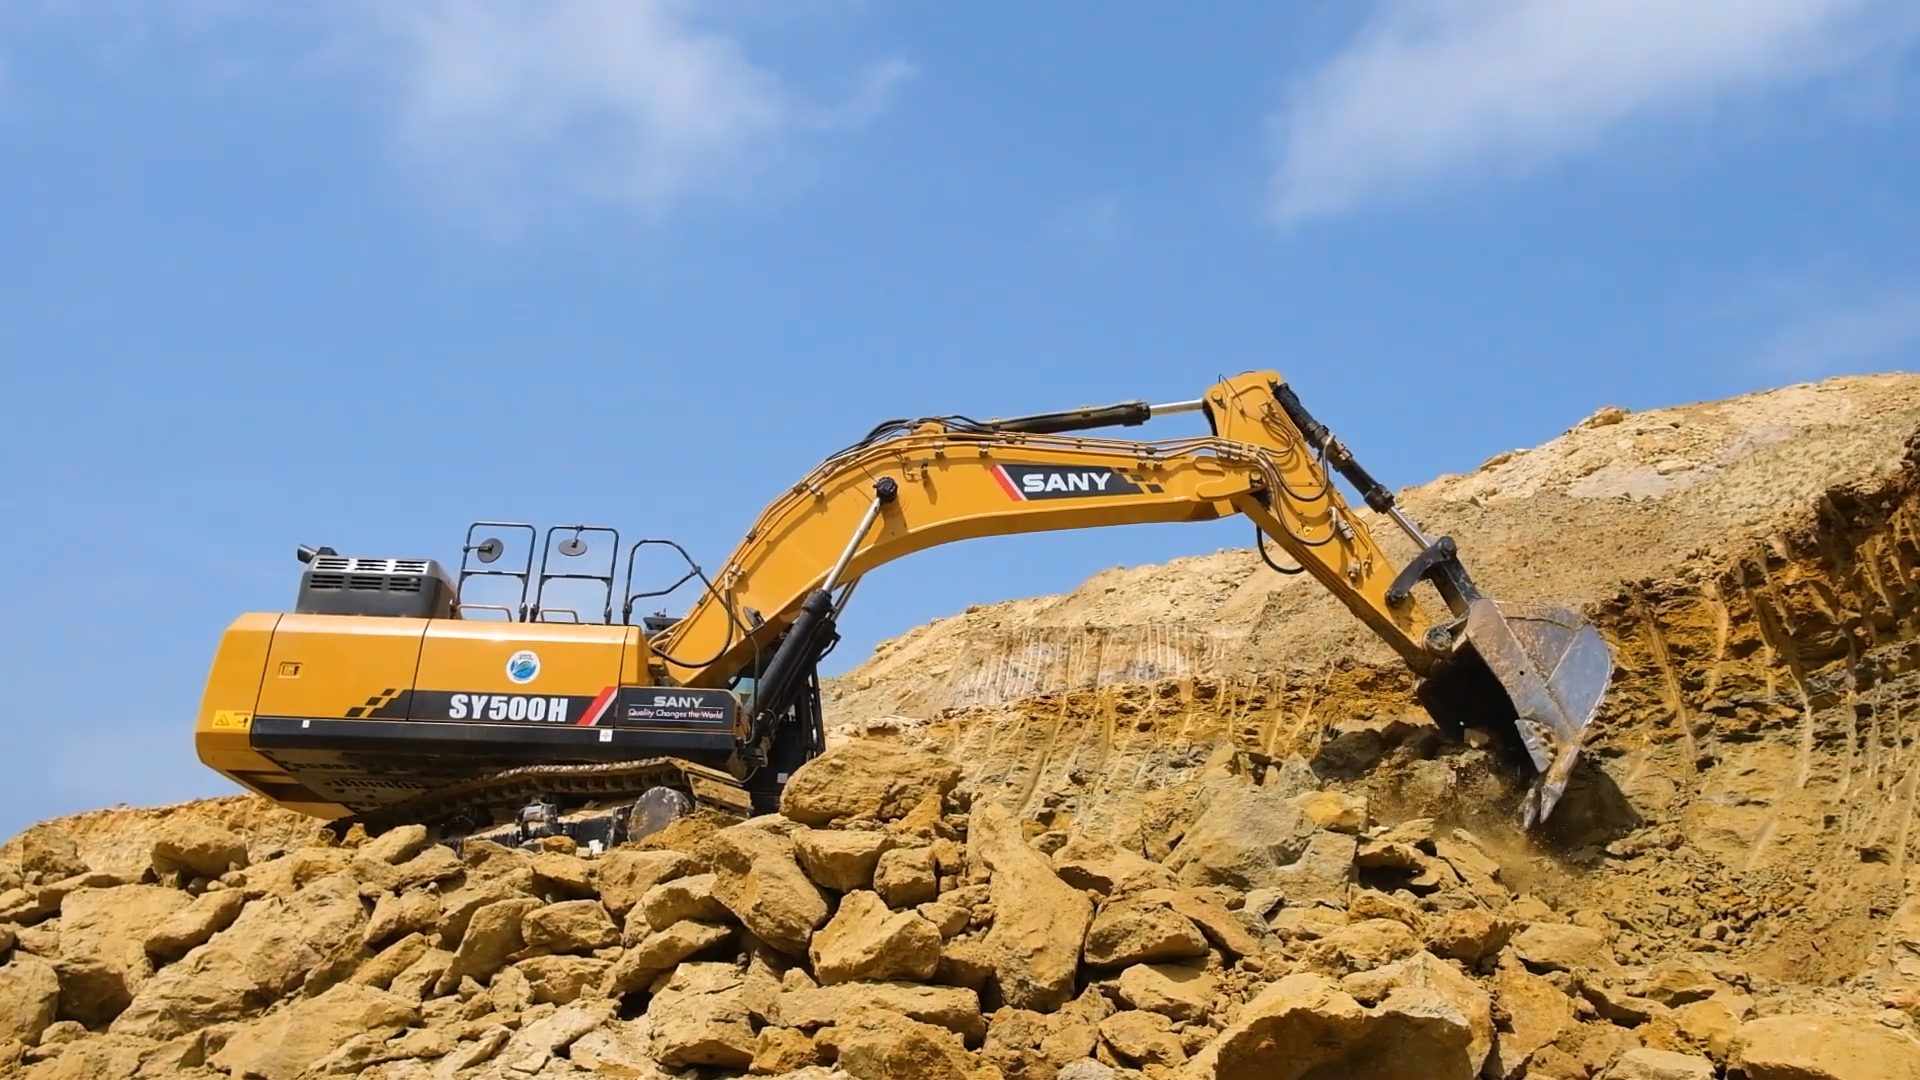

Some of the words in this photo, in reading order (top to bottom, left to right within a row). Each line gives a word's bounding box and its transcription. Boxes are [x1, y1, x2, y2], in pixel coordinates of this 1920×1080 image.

[1022, 472, 1111, 492] SANY
[449, 694, 569, 722] SY500H
[653, 696, 704, 708] SANY
[628, 708, 655, 718] Quality
[656, 709, 687, 719] Changes
[688, 710, 700, 718] the
[701, 710, 723, 719] World
